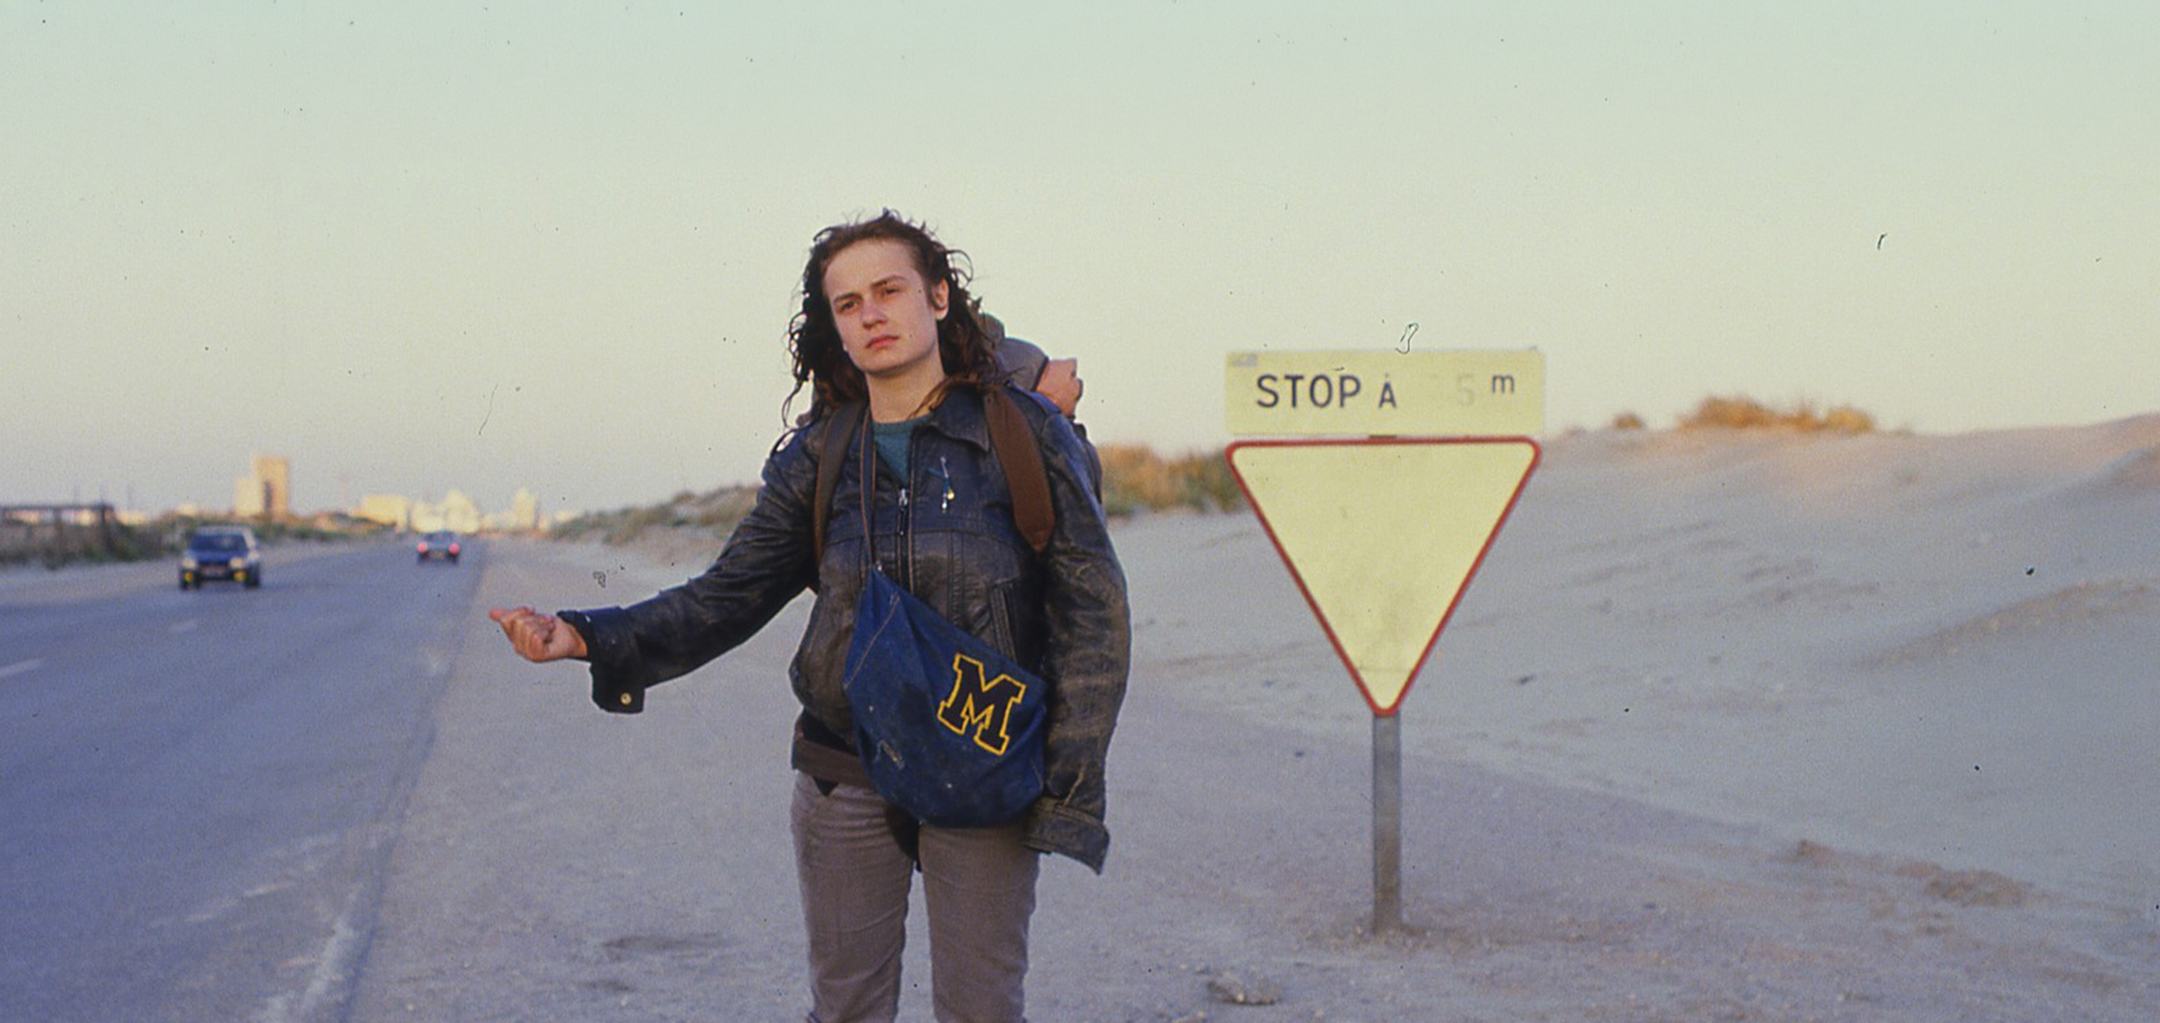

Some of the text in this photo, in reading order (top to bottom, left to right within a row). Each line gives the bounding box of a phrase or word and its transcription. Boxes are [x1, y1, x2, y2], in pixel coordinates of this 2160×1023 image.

[1256, 373, 1361, 408] STOP
[1491, 373, 1516, 394] m
[938, 653, 1027, 755] M
